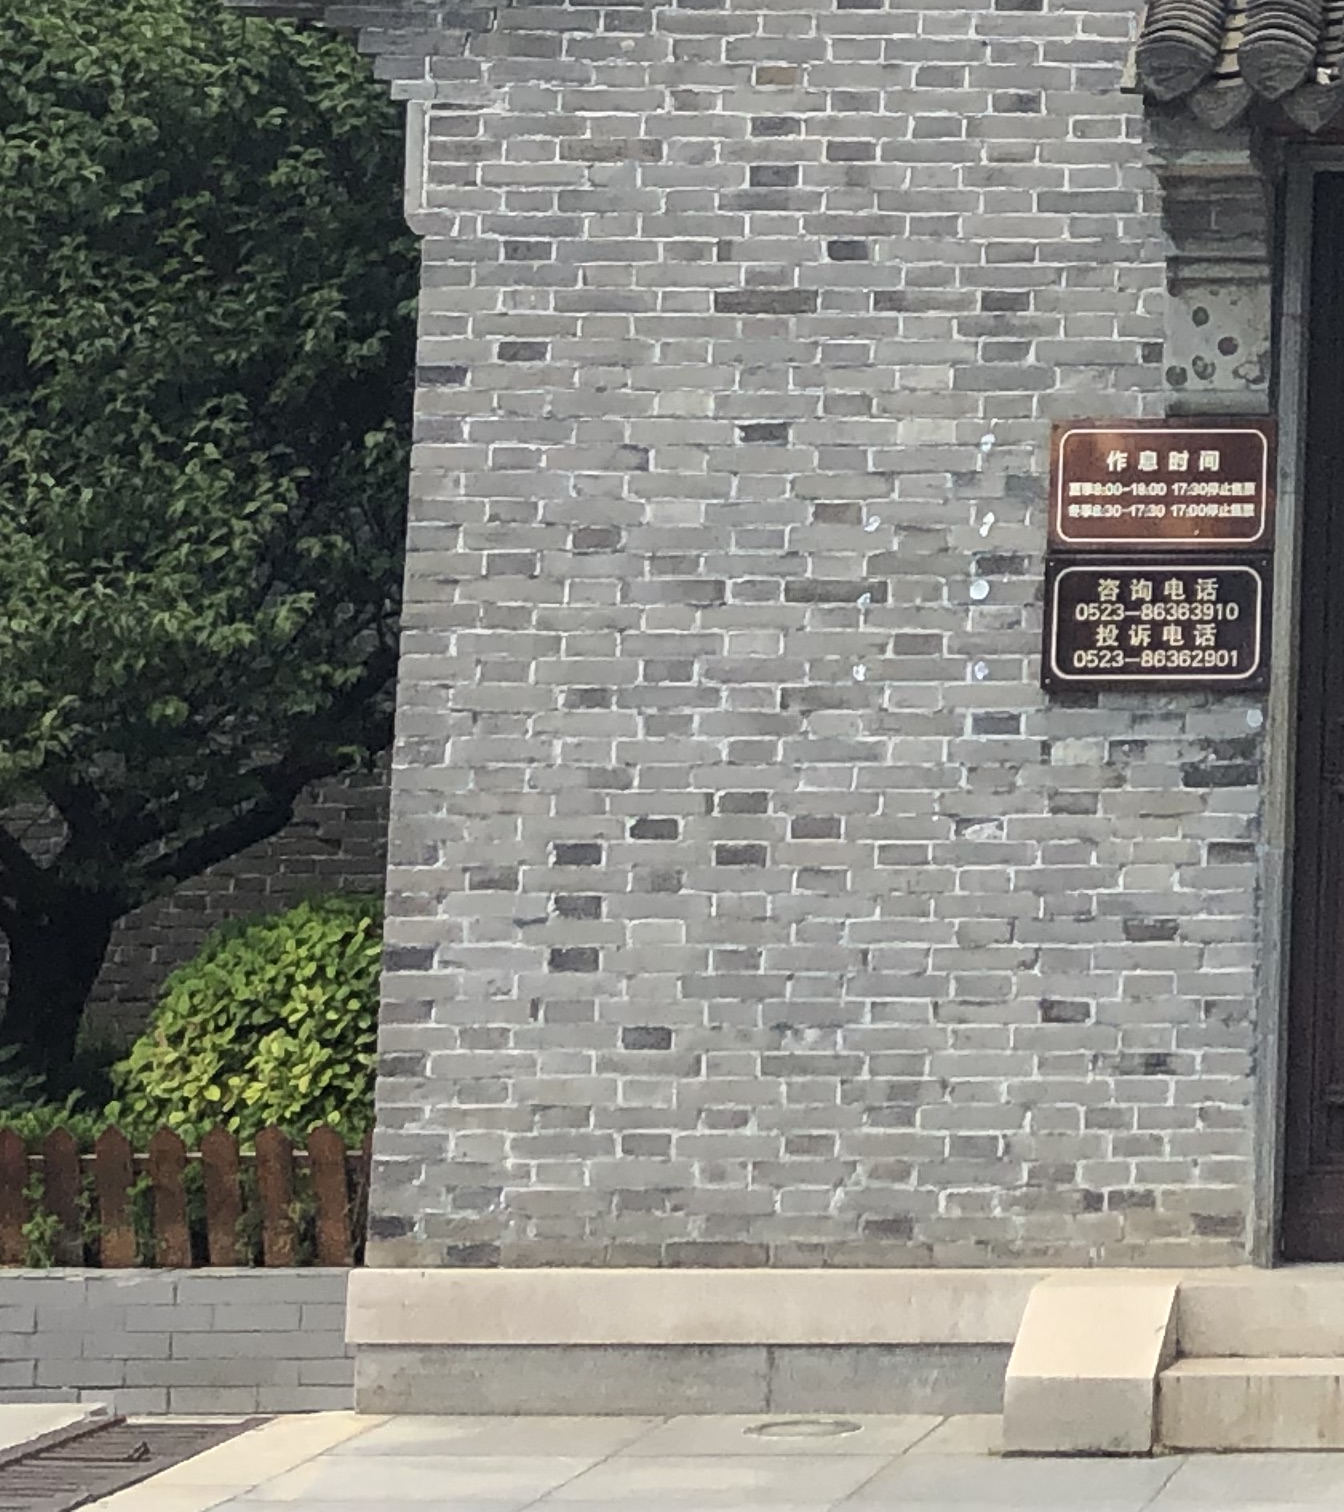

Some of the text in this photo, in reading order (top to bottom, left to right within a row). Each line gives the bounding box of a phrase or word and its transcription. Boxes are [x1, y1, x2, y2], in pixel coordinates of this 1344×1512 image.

[1106, 449, 1221, 472] 作息时间
[1097, 577, 1219, 602] 咨询电话
[1095, 623, 1218, 648] 投诉电话
